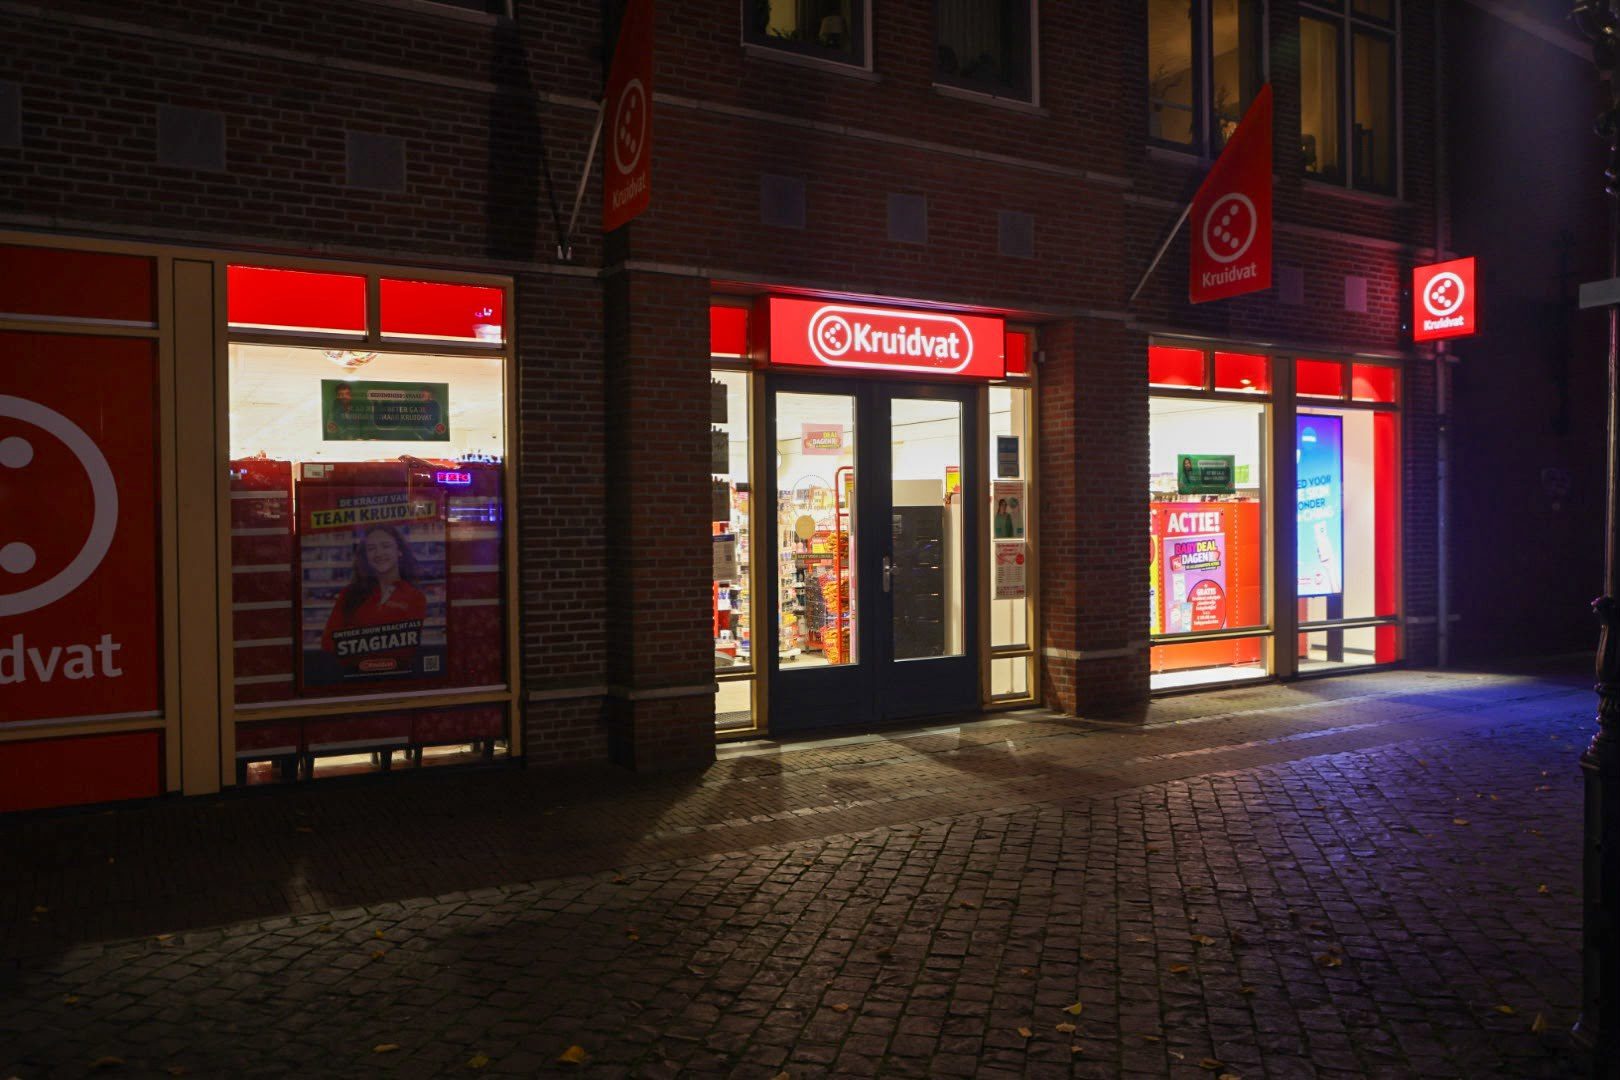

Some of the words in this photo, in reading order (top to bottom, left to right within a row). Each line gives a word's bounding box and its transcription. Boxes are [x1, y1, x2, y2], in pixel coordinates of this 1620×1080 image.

[612, 172, 647, 211] Kruidvat
[1202, 262, 1257, 289] Kruidvat
[1424, 315, 1465, 331] Kruidvat
[854, 323, 960, 359] Kruidvat
[1309, 475, 1332, 486] VOOR
[340, 497, 353, 507] DE
[353, 494, 388, 506] KRACHT
[391, 492, 409, 503] VAN
[313, 510, 356, 526] TEAM
[360, 502, 434, 521] KRUIDVAT
[1167, 511, 1220, 533] ACTIE!
[1196, 540, 1217, 553] DEAL
[333, 629, 361, 638] ONTDEK
[382, 622, 407, 632] KRACHT
[408, 620, 422, 629] ALS
[337, 631, 418, 656] STAGIAIR
